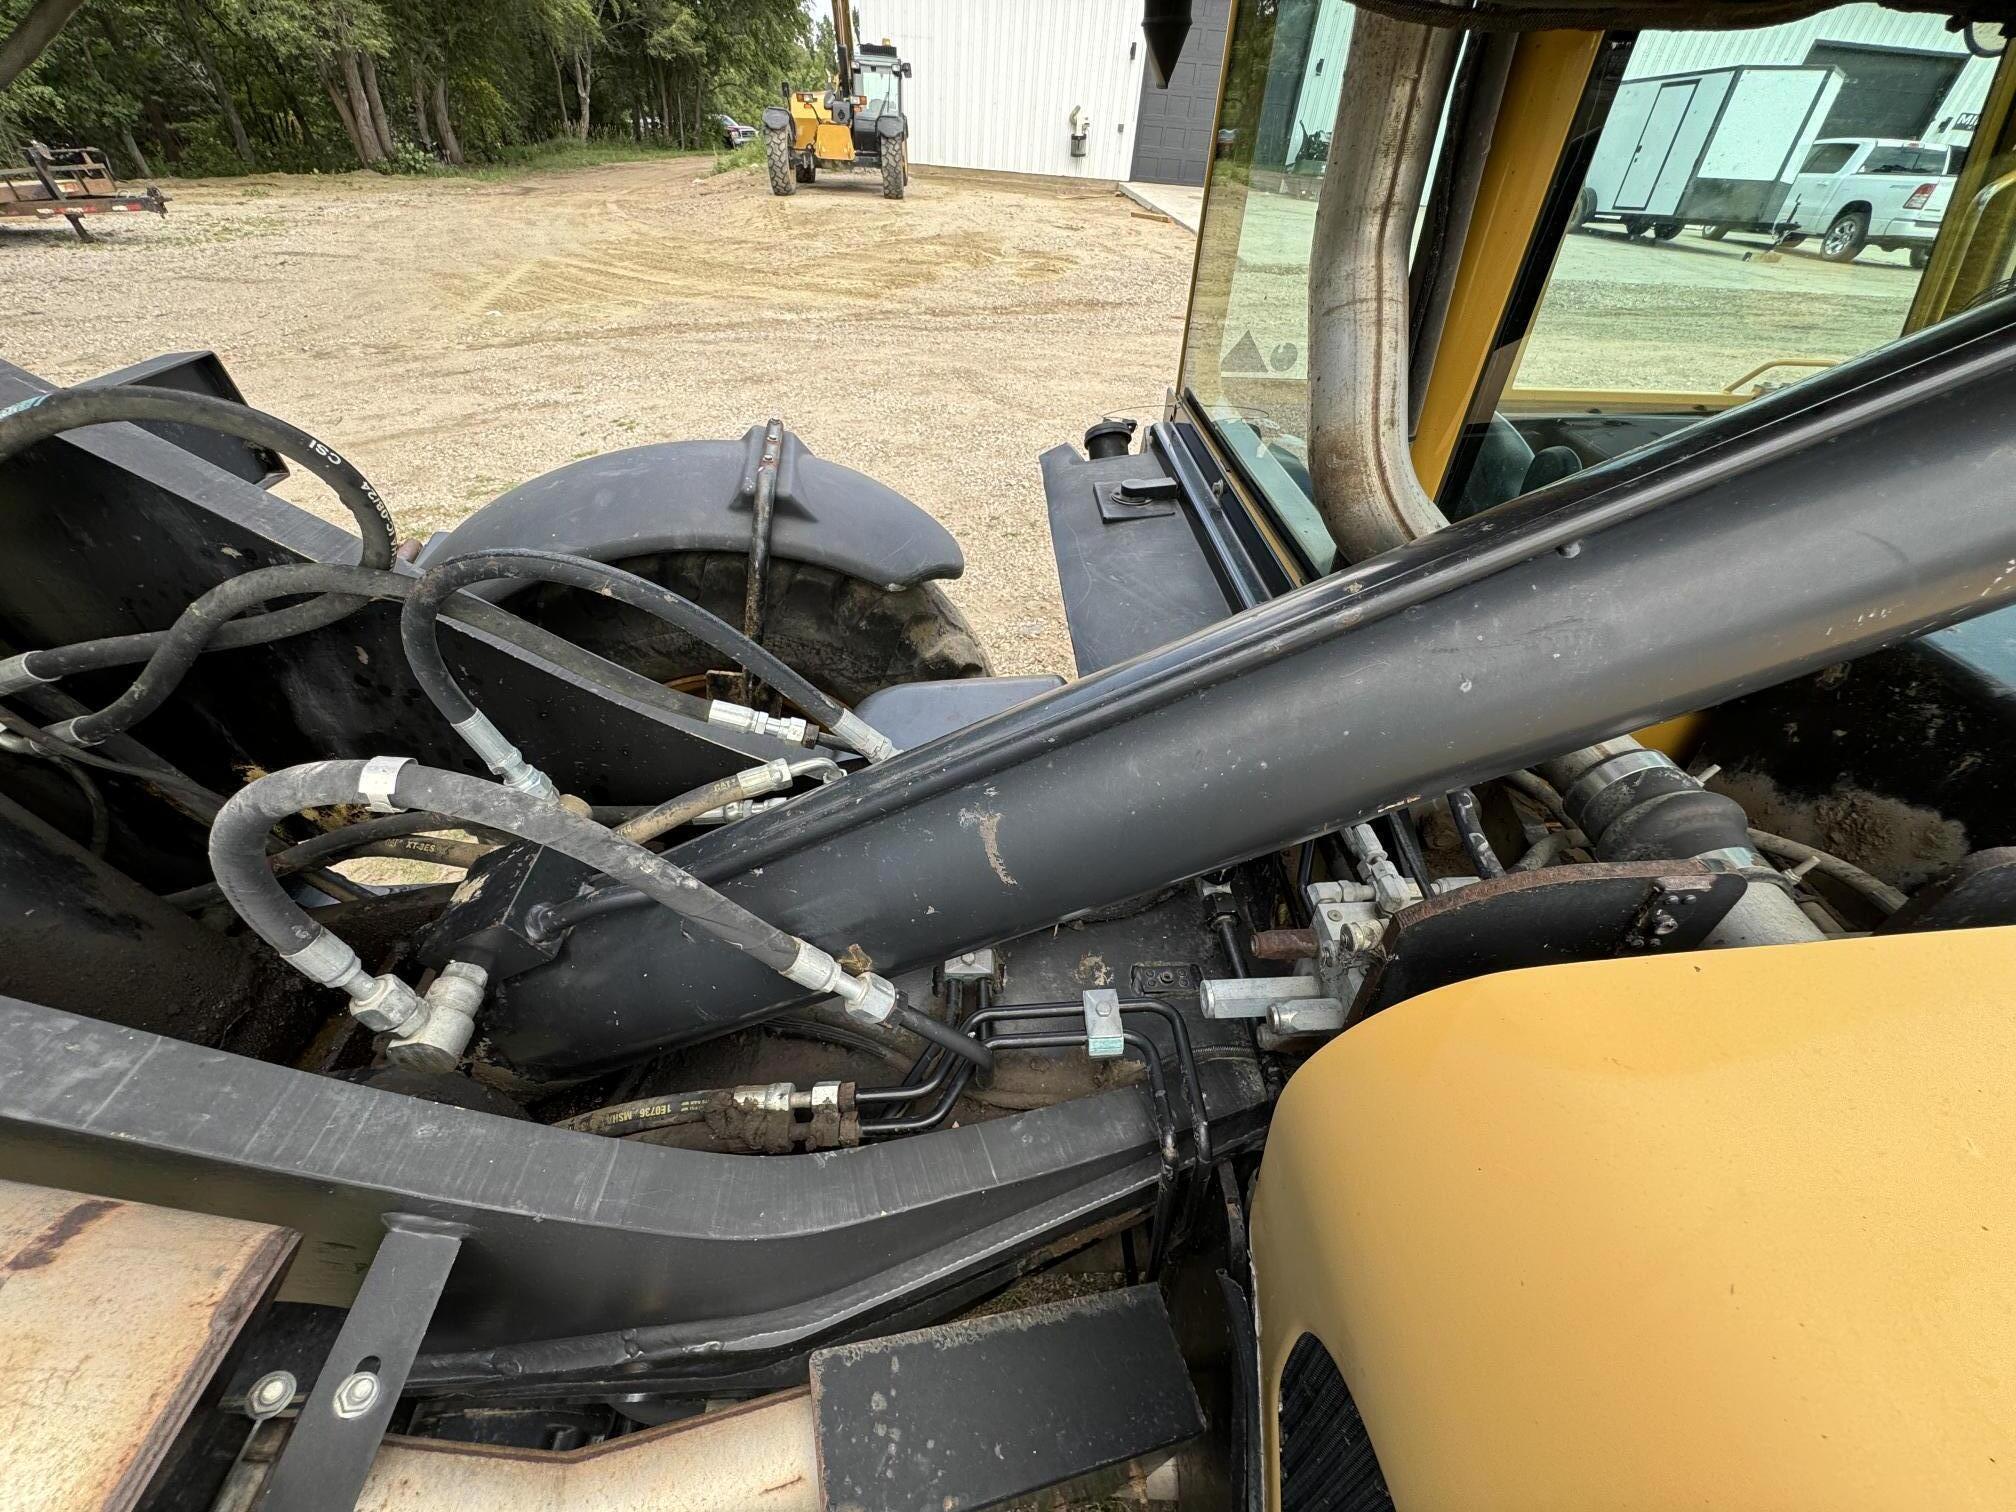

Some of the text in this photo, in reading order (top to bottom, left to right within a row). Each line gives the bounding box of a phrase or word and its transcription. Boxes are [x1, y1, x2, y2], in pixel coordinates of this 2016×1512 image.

[309, 440, 341, 465] CSI
[405, 840, 436, 853] XT-3ES
[639, 1104, 672, 1118] 1E0736
